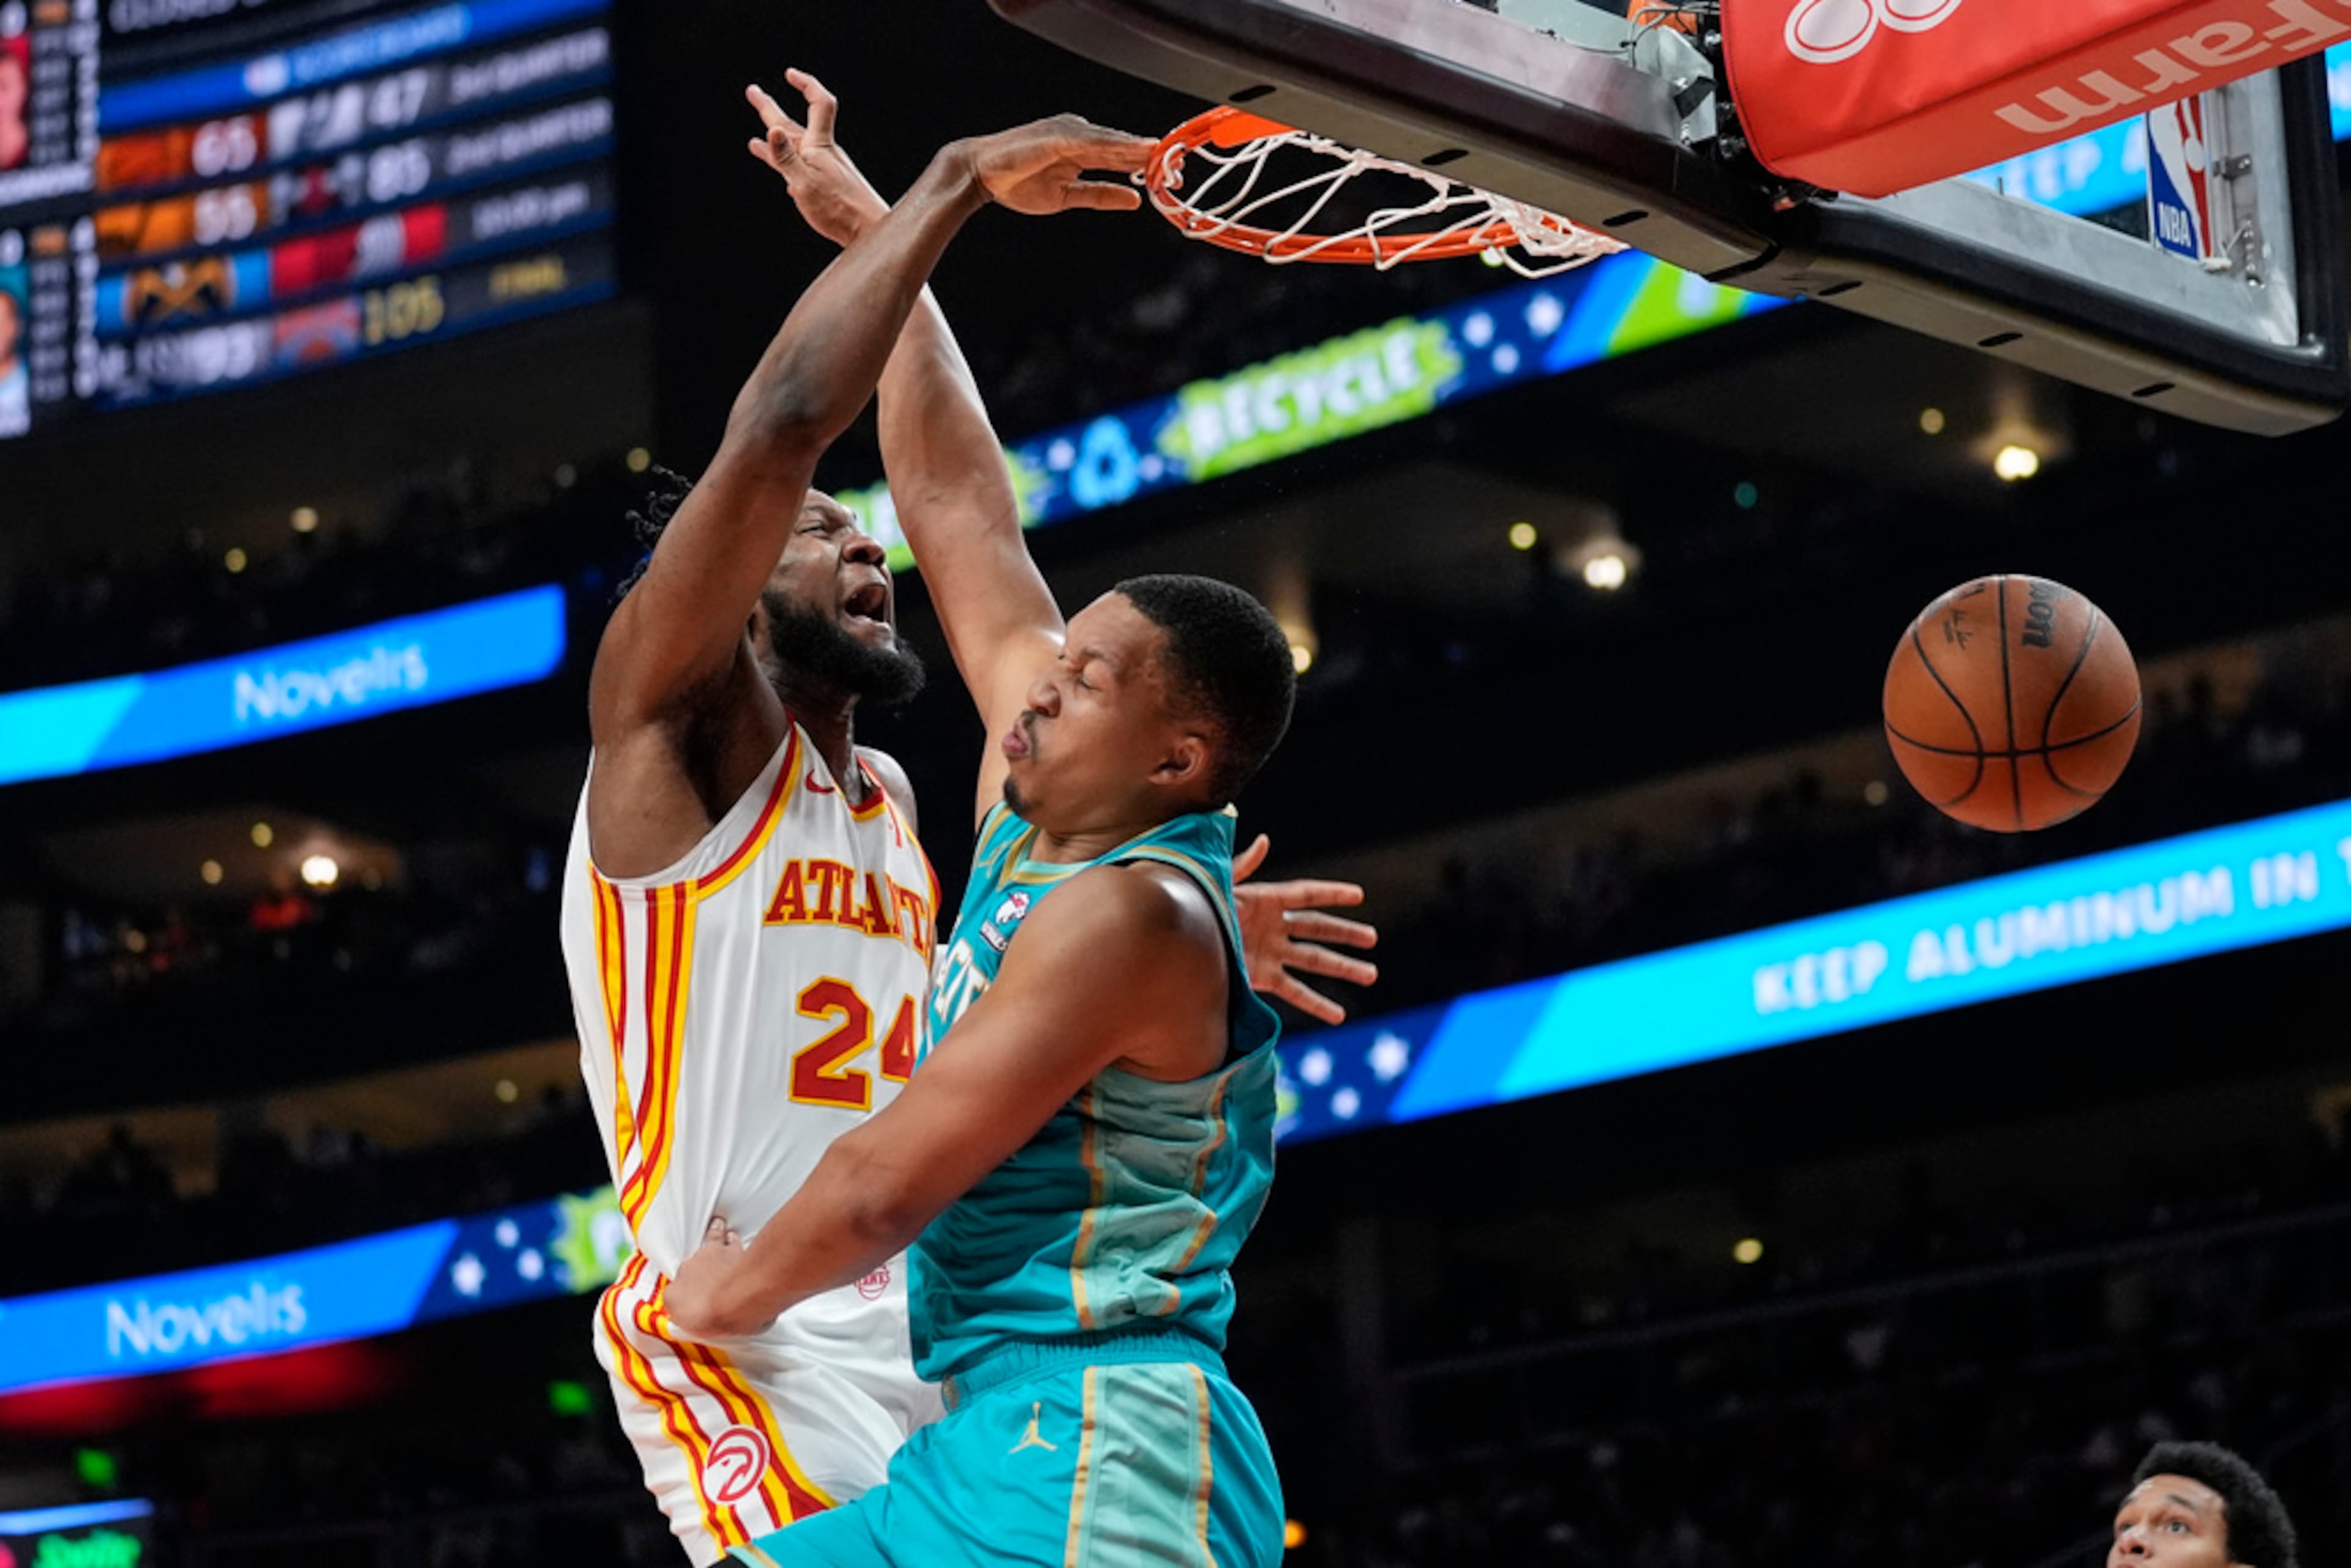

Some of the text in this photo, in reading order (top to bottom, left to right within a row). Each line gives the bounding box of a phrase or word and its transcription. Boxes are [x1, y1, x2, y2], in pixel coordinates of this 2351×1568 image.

[1993, 0, 2350, 133] Farm
[2158, 202, 2192, 247] NBA
[364, 279, 444, 344] 105
[1185, 327, 1424, 459] RECYCLE
[233, 644, 427, 722] Novelis
[763, 858, 931, 967] ATLANT
[1753, 939, 1888, 1014] KEEP
[1906, 865, 2234, 981] ALUMINUM
[2251, 851, 2319, 910] IN
[789, 975, 917, 1111] 24
[107, 1279, 307, 1356] Novelis
